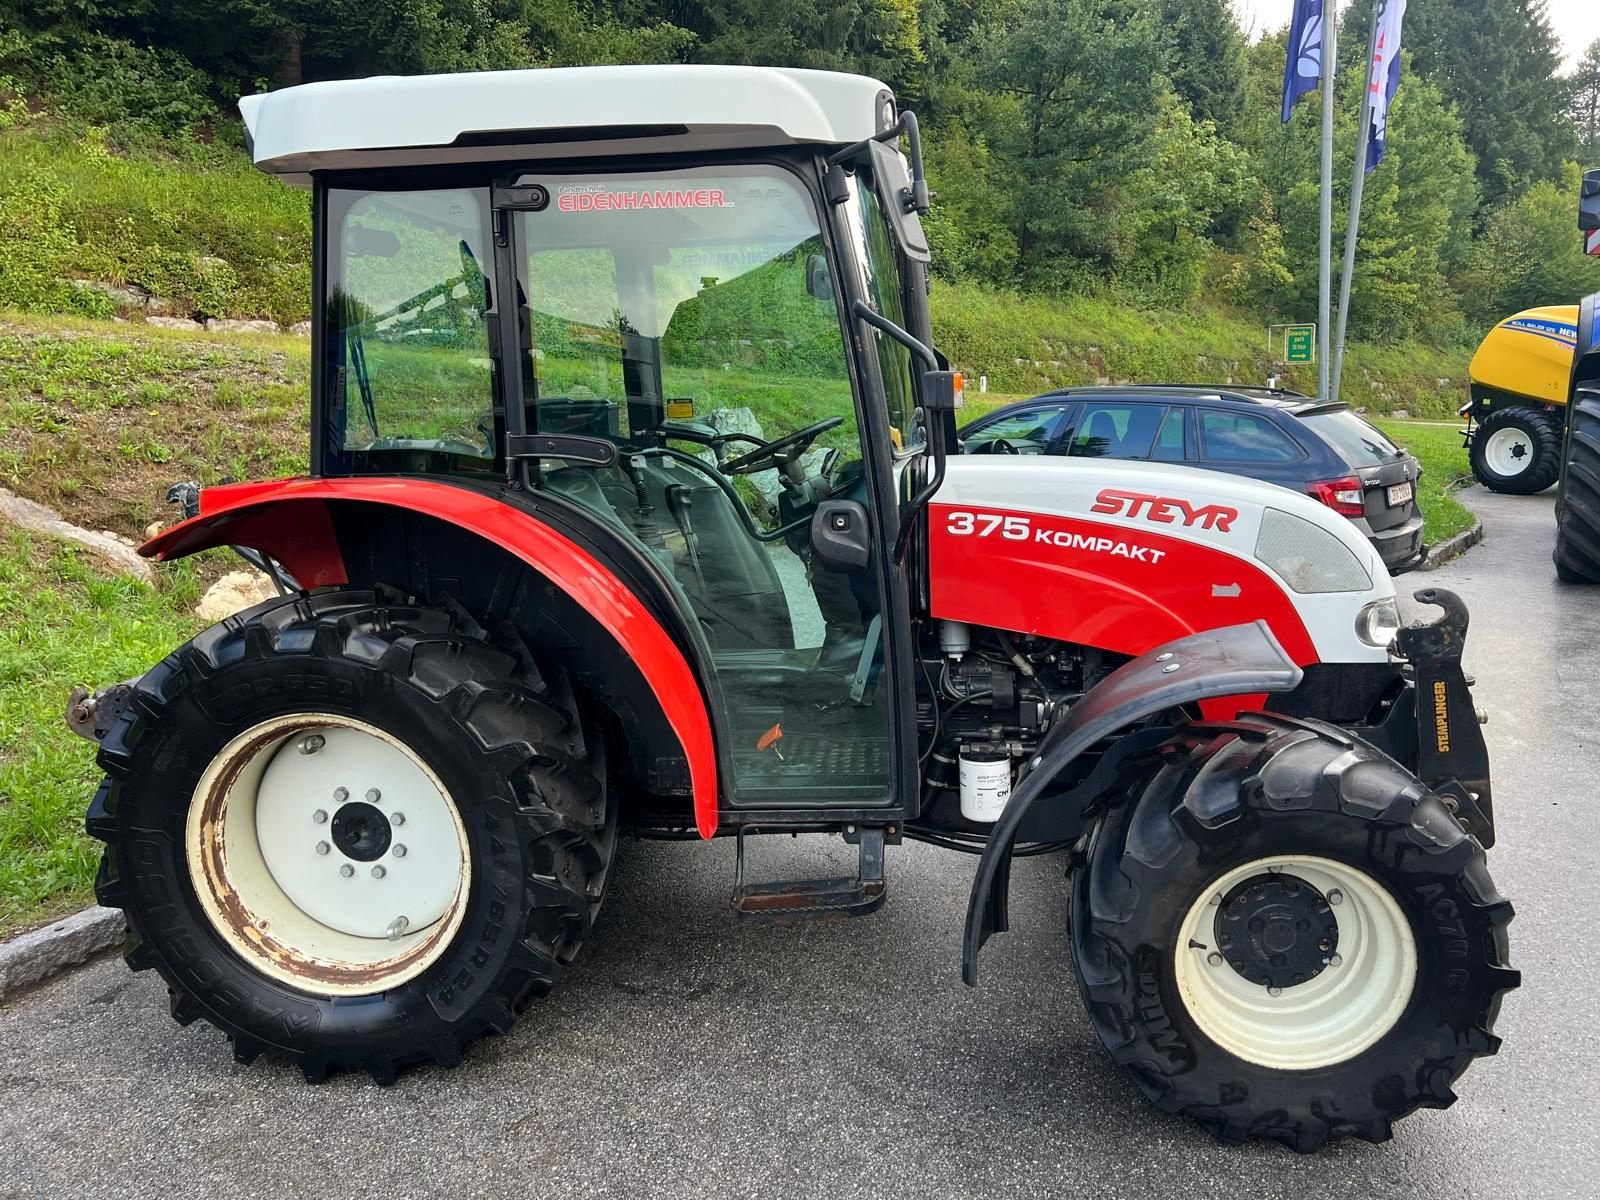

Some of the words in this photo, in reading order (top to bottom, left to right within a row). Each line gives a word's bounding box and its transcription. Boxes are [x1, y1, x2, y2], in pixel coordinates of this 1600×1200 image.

[558, 188, 725, 212] EIDENHAMMER
[1089, 487, 1239, 534] STEYR
[946, 511, 1031, 542] 375
[1034, 528, 1166, 565] KOMPAKT
[1433, 680, 1451, 754] STEMPLINGER
